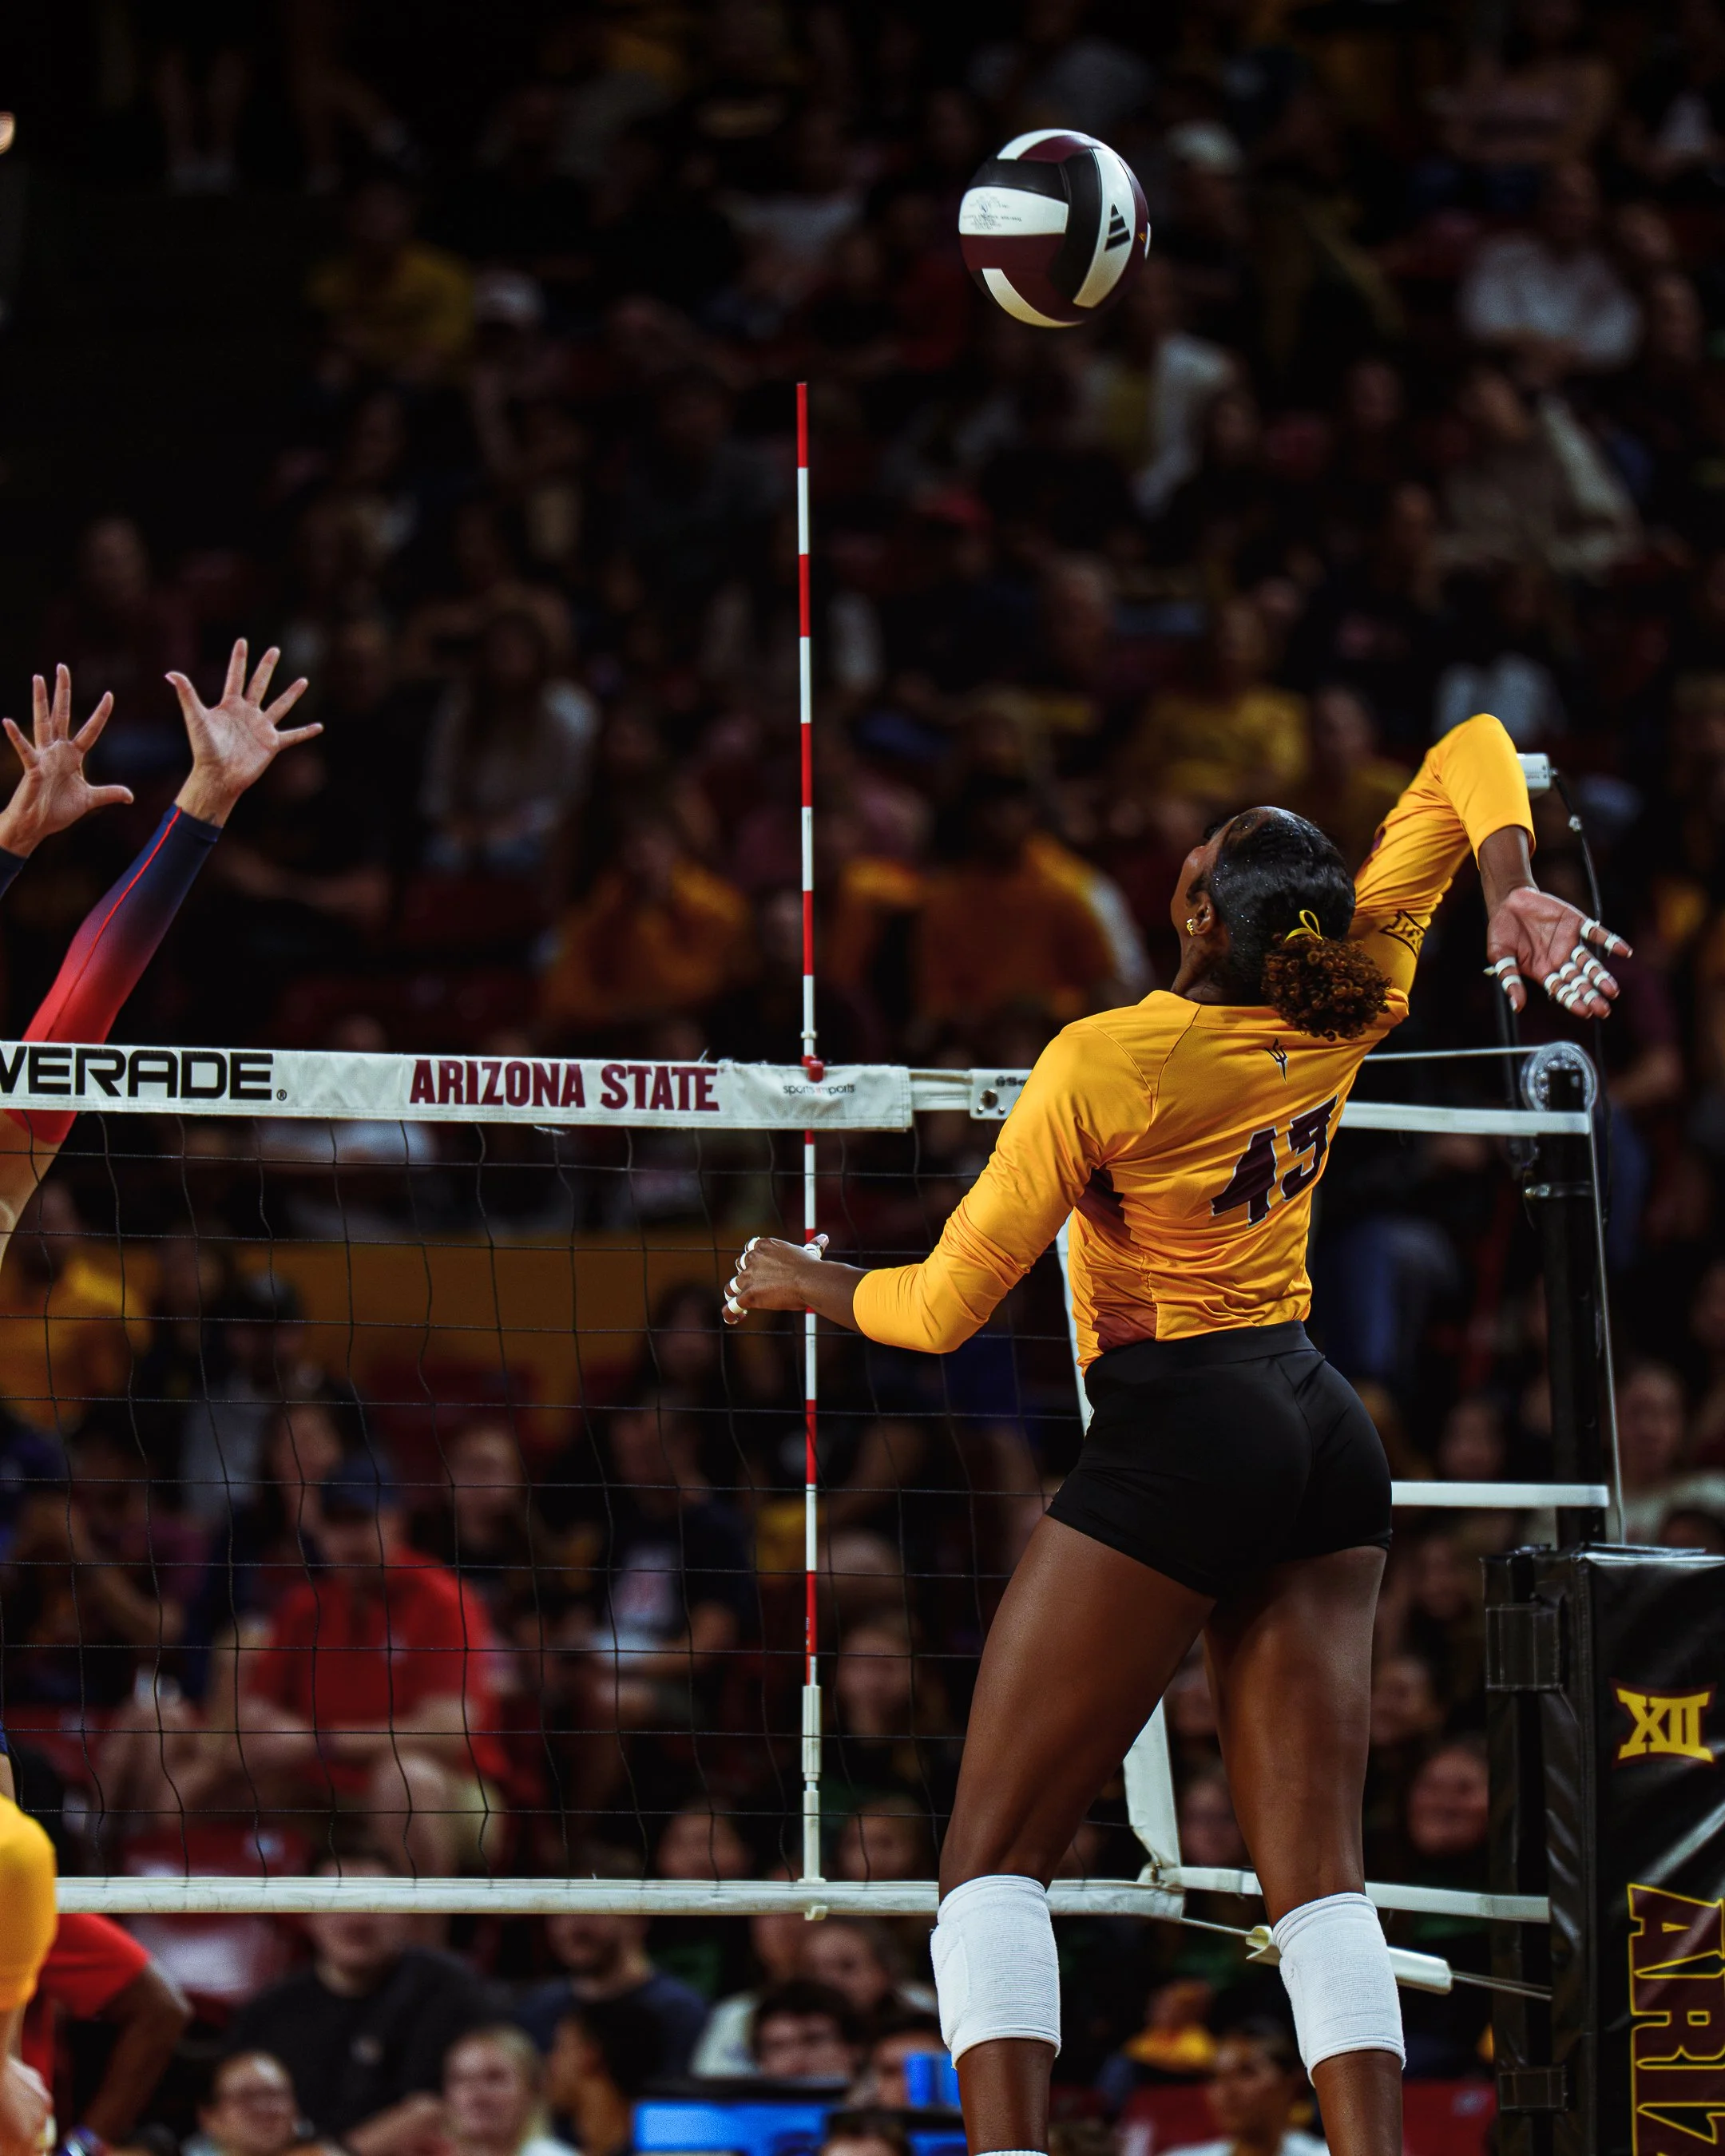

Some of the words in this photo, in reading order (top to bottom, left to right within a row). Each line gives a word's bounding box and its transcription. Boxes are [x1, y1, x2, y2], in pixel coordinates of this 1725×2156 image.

[409, 1059, 586, 1108] ARIZONA
[600, 1064, 720, 1112] STATE
[1616, 1687, 1714, 1763] XII
